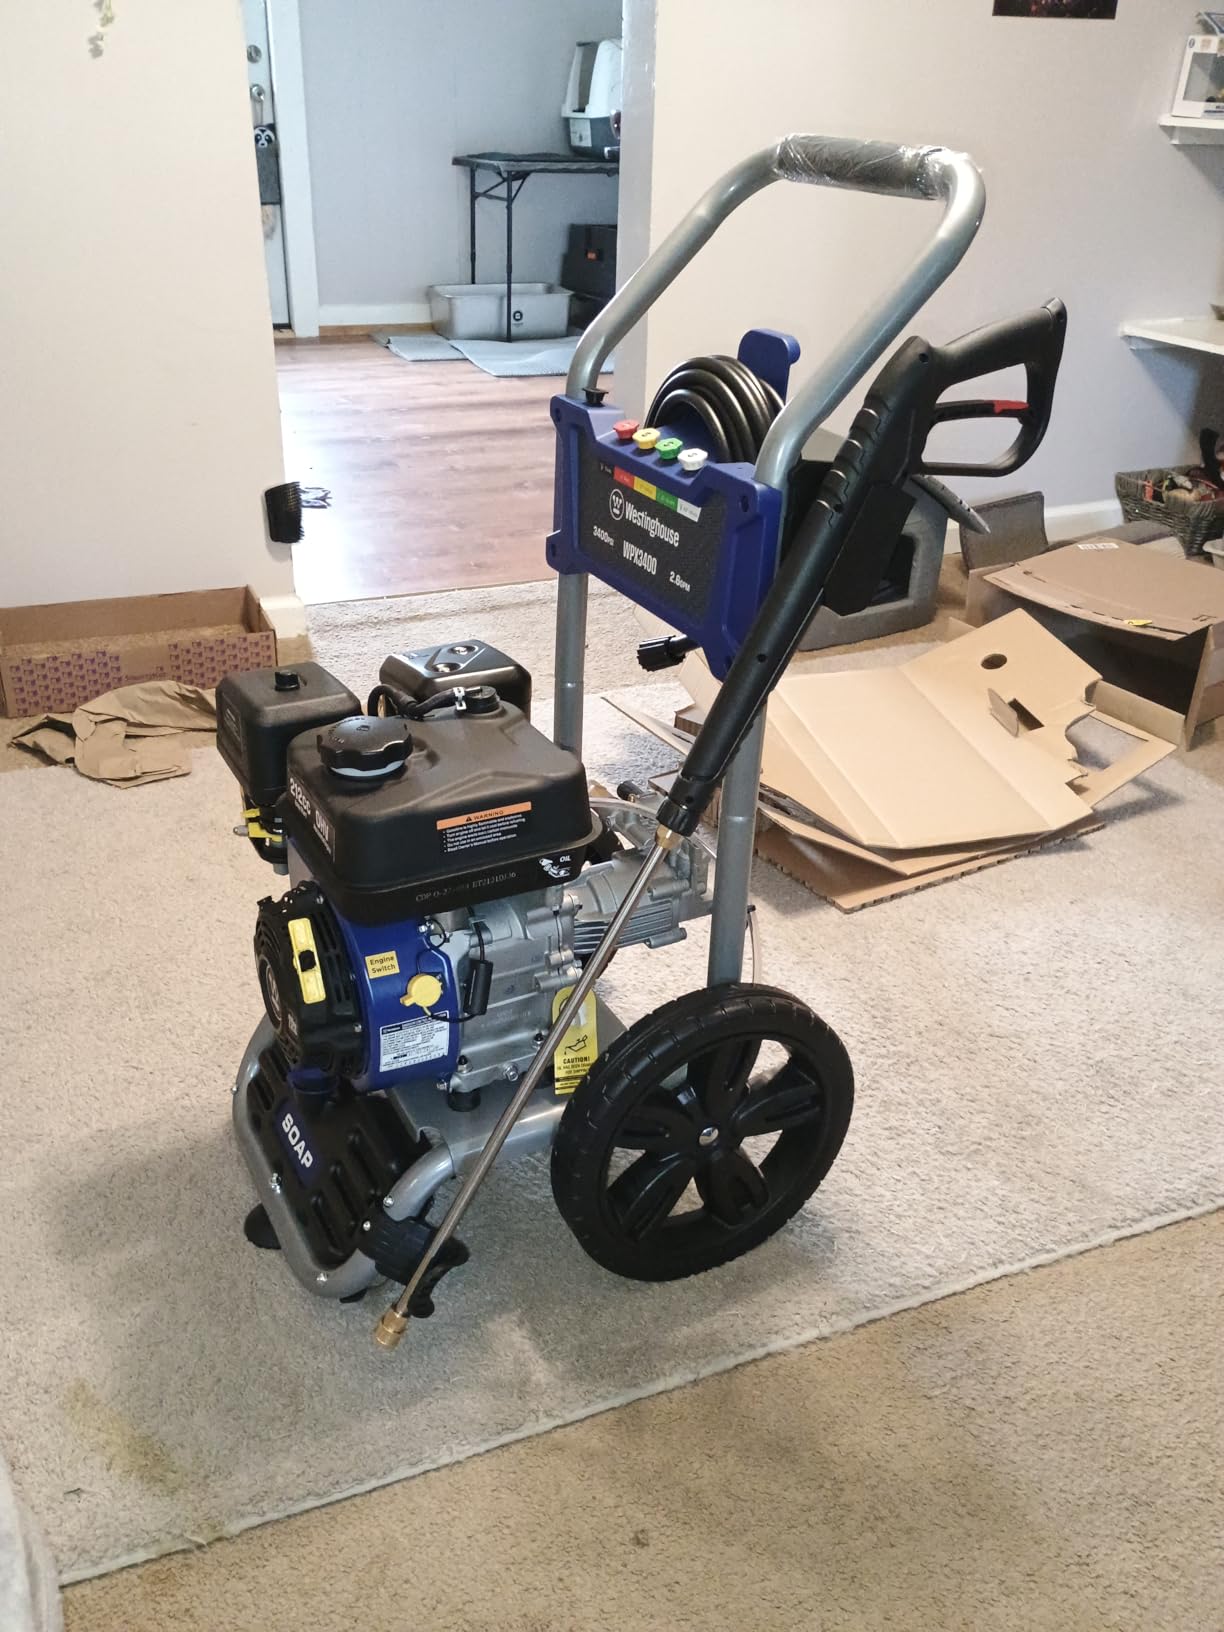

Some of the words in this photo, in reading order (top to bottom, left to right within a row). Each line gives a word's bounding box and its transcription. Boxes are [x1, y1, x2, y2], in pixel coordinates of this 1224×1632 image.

[625, 501, 680, 547] Westinghouse
[622, 540, 658, 575] WPX3400
[473, 810, 504, 821] WARNING
[559, 855, 572, 863] OIL
[369, 956, 394, 966] Engine
[371, 964, 396, 974] Switch
[563, 1056, 590, 1064] CAUTION!
[282, 1113, 313, 1168] SOAP
